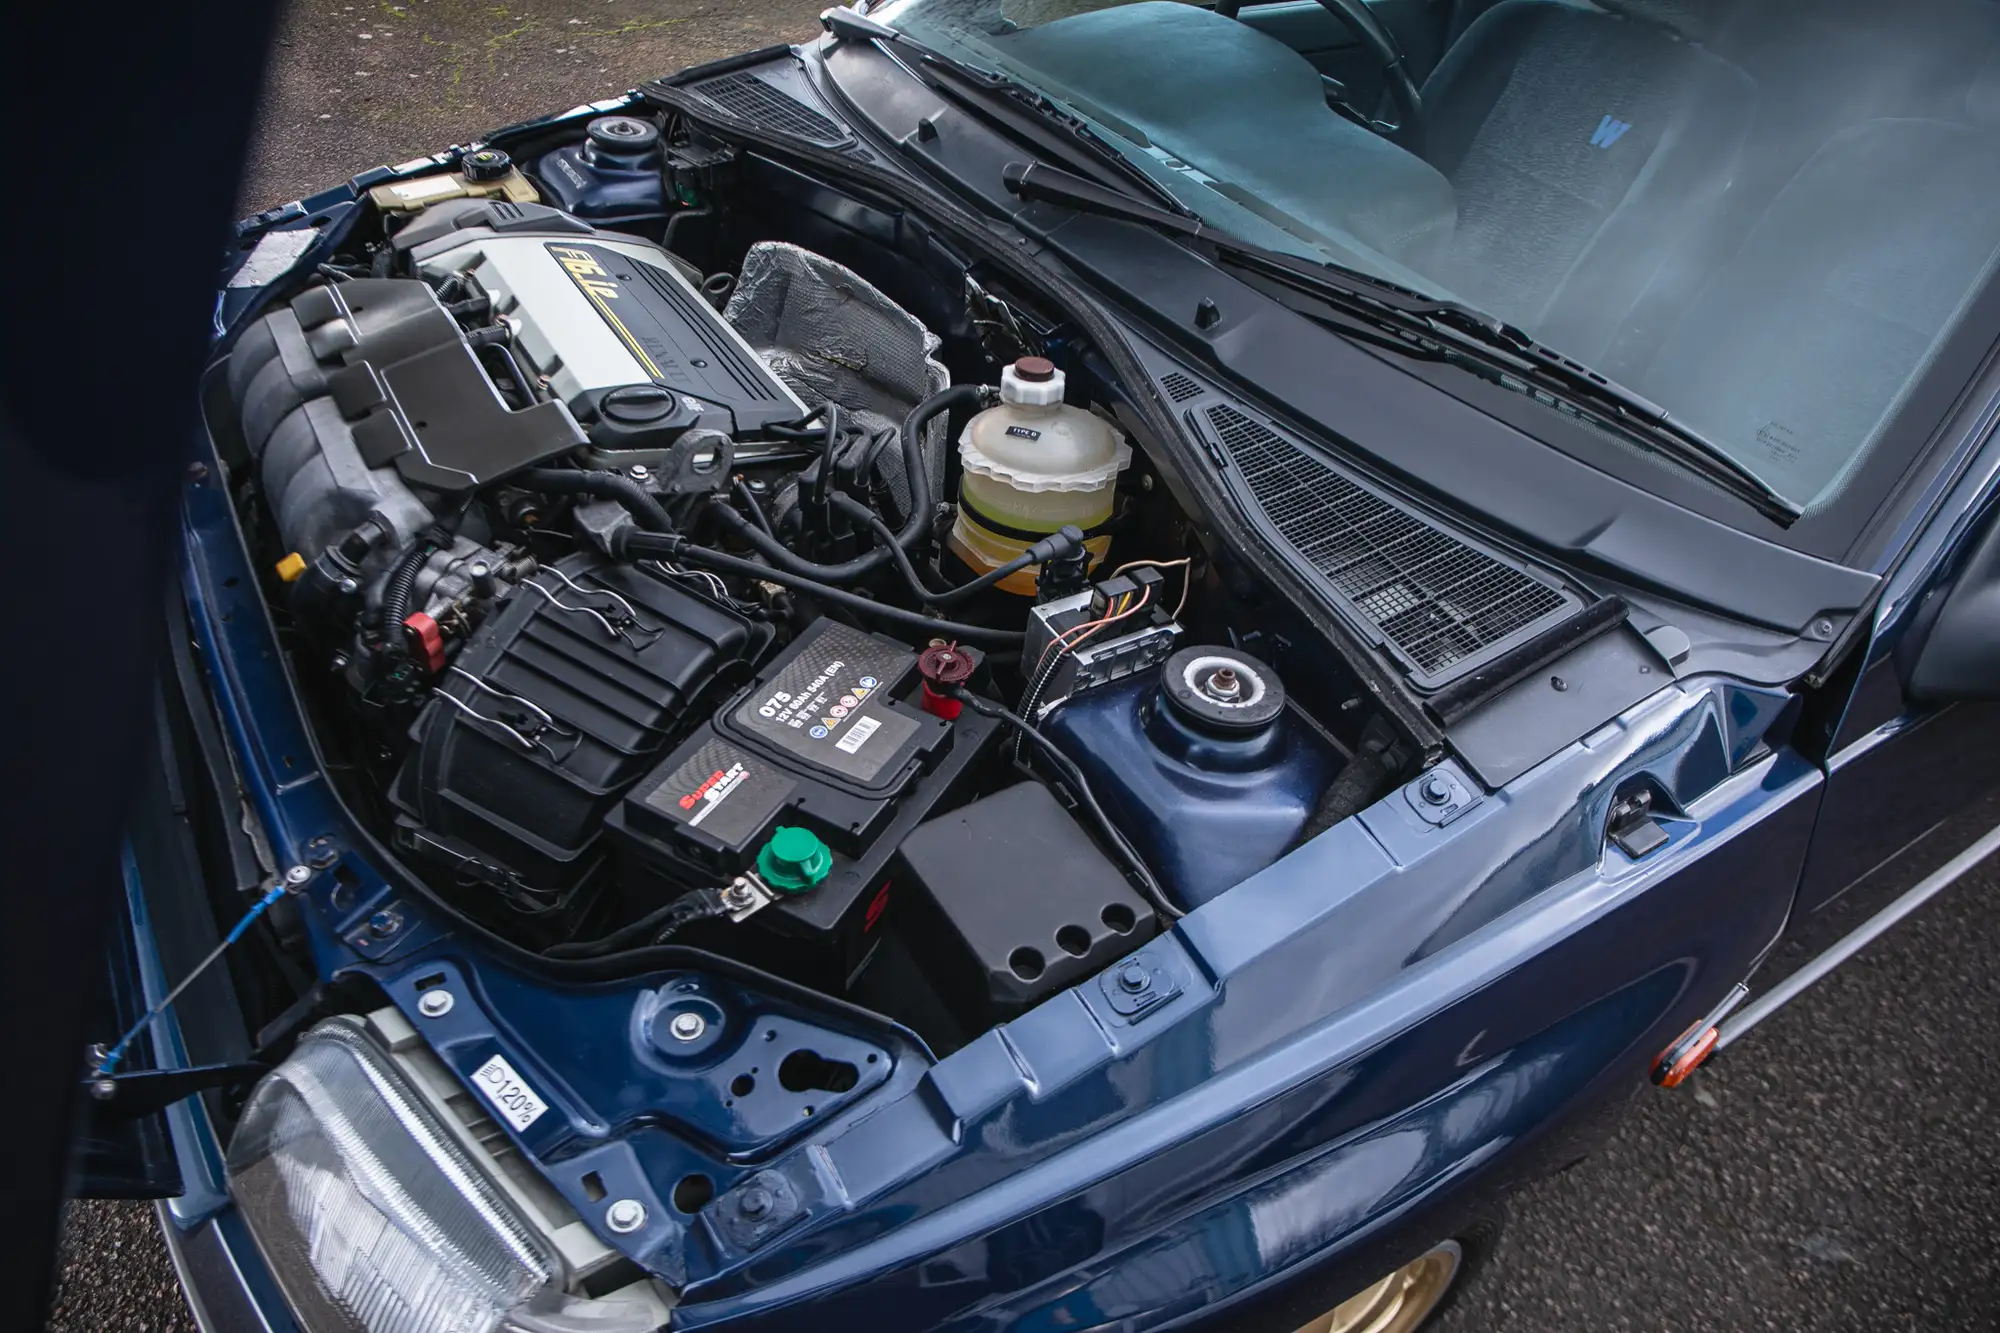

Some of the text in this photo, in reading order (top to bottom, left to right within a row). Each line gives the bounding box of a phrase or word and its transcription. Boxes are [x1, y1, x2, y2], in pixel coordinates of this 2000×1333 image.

[1590, 115, 1632, 148] W
[681, 396, 704, 412] elf
[758, 691, 791, 717] 075
[775, 708, 793, 723] 12V
[789, 691, 812, 710] 60Ah
[807, 675, 830, 693] 540A
[824, 660, 845, 677] (EN)
